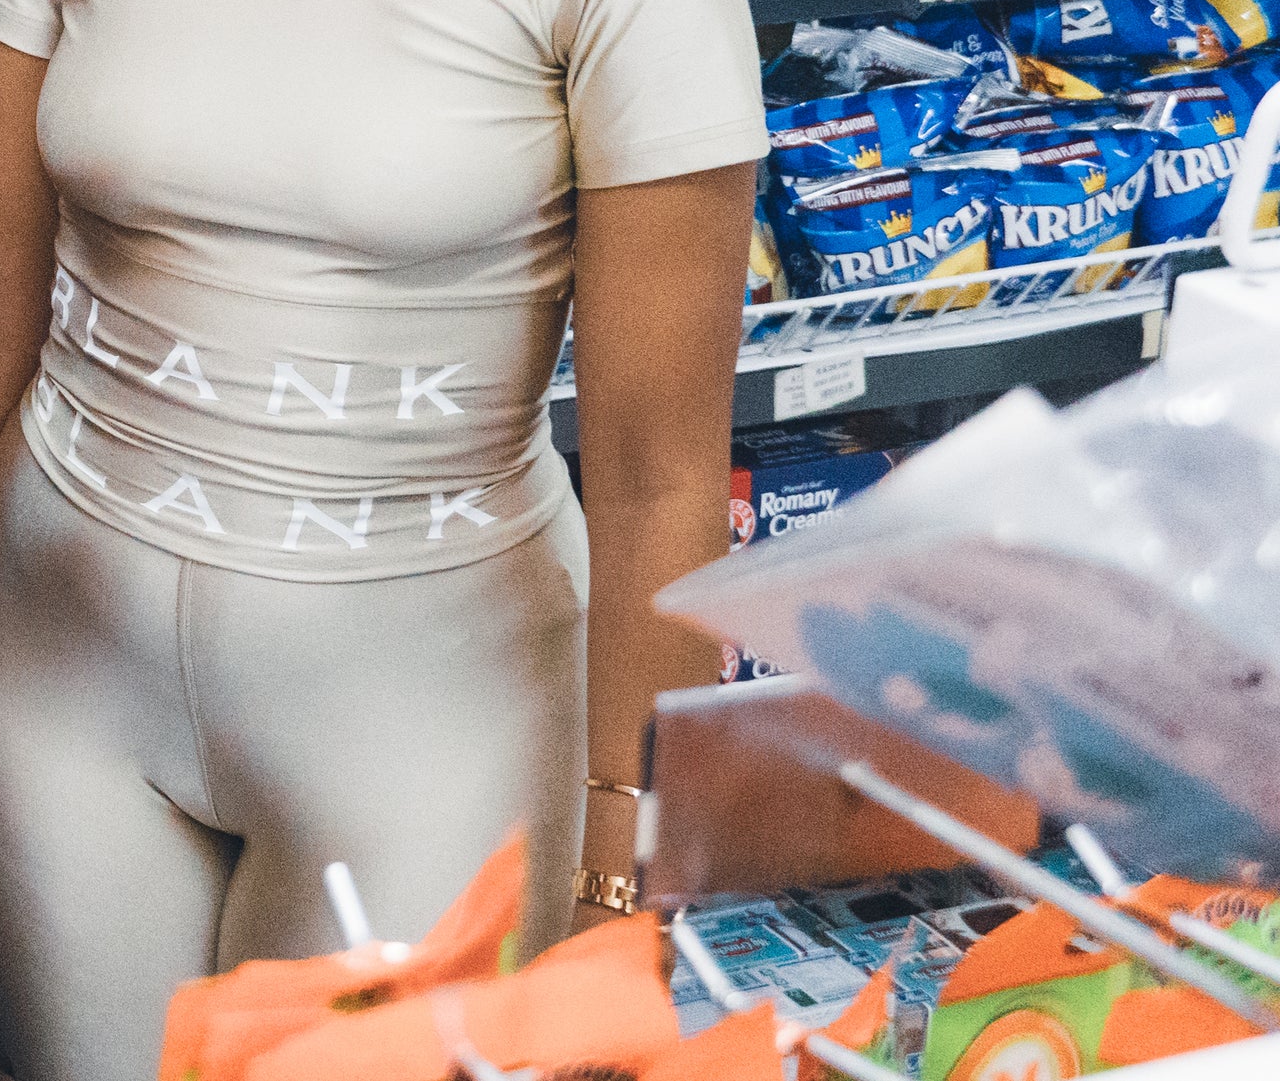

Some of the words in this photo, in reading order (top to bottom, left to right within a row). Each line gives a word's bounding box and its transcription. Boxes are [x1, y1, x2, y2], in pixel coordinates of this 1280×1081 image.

[1152, 137, 1244, 199] KRU
[1001, 160, 1149, 251] KRUNC
[759, 486, 840, 519] Romany
[769, 508, 838, 537] Cream
